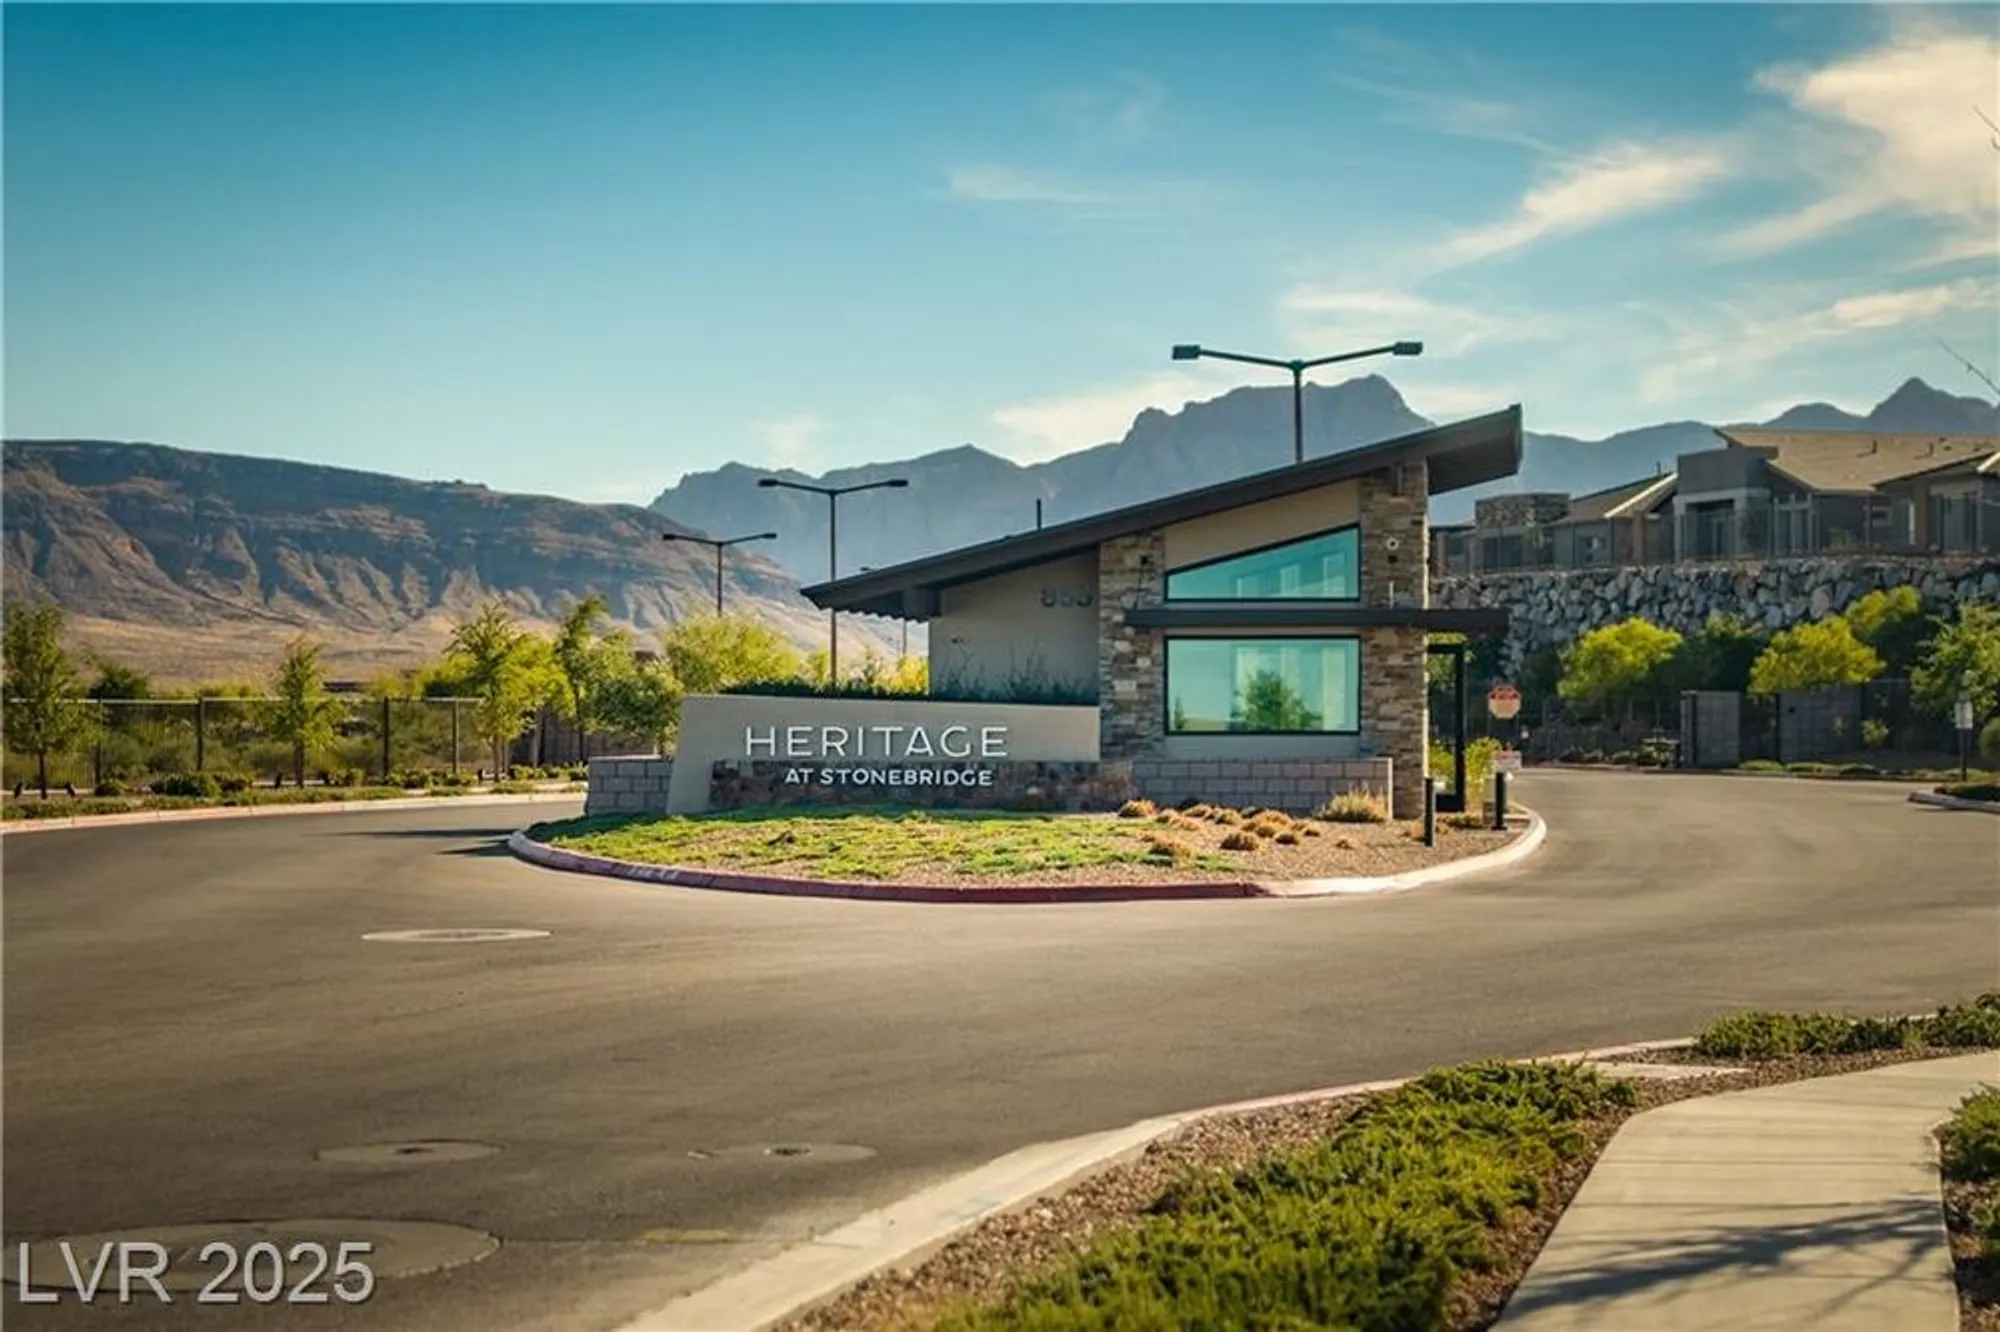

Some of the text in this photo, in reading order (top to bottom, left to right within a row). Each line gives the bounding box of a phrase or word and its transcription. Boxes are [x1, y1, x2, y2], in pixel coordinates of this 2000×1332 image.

[745, 725, 1009, 758] HERITAGE
[784, 768, 993, 786] AT STONEBRIDGE
